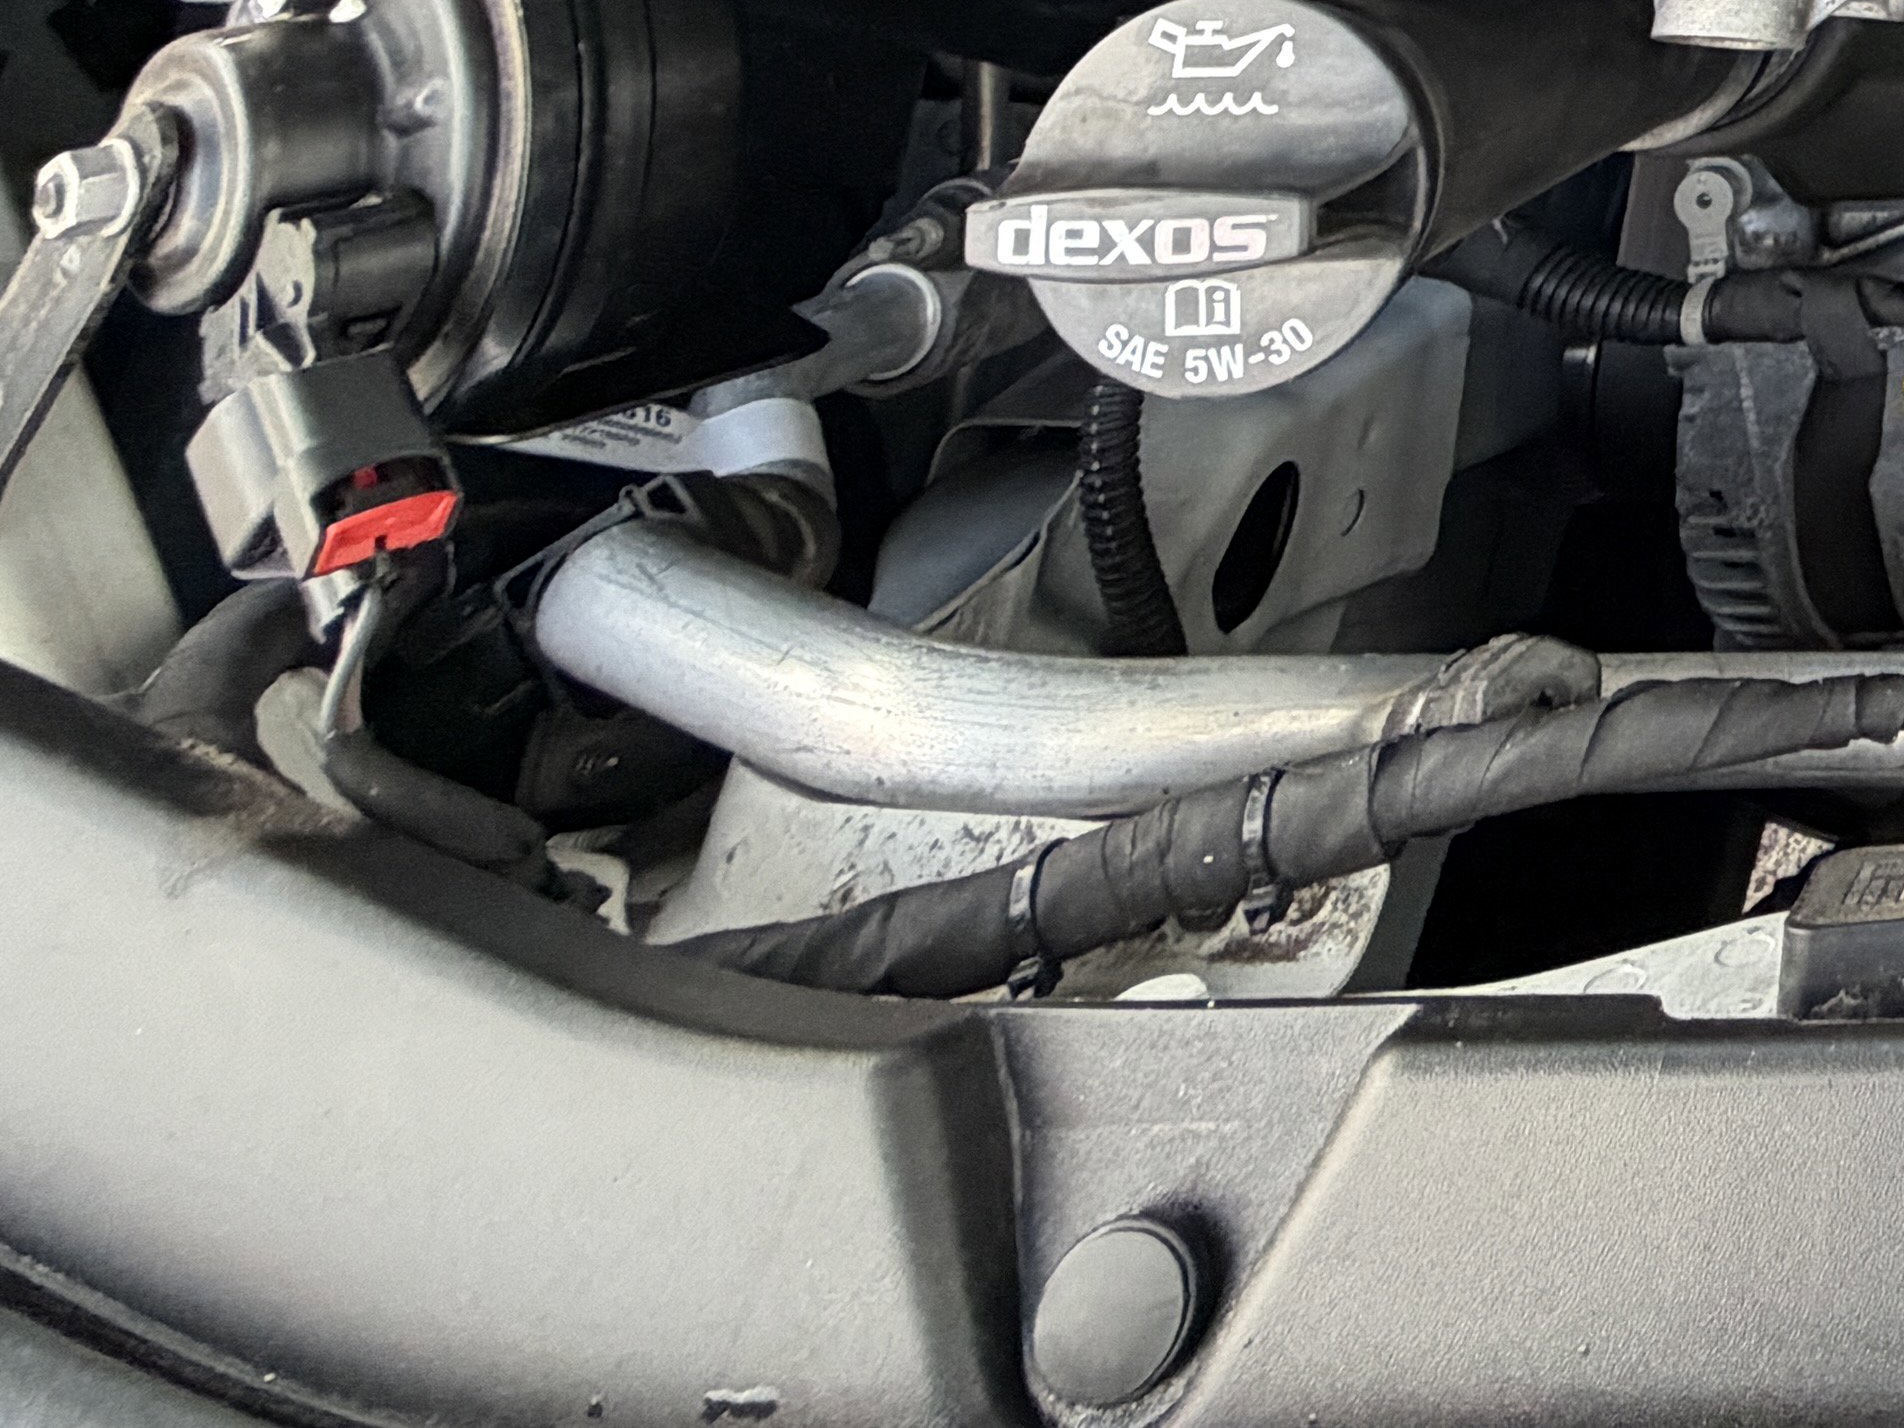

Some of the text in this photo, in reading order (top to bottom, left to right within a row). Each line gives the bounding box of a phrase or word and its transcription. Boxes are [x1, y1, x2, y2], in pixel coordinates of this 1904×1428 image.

[995, 205, 1268, 267] dexos
[1097, 316, 1314, 384] SAE 5W-30
